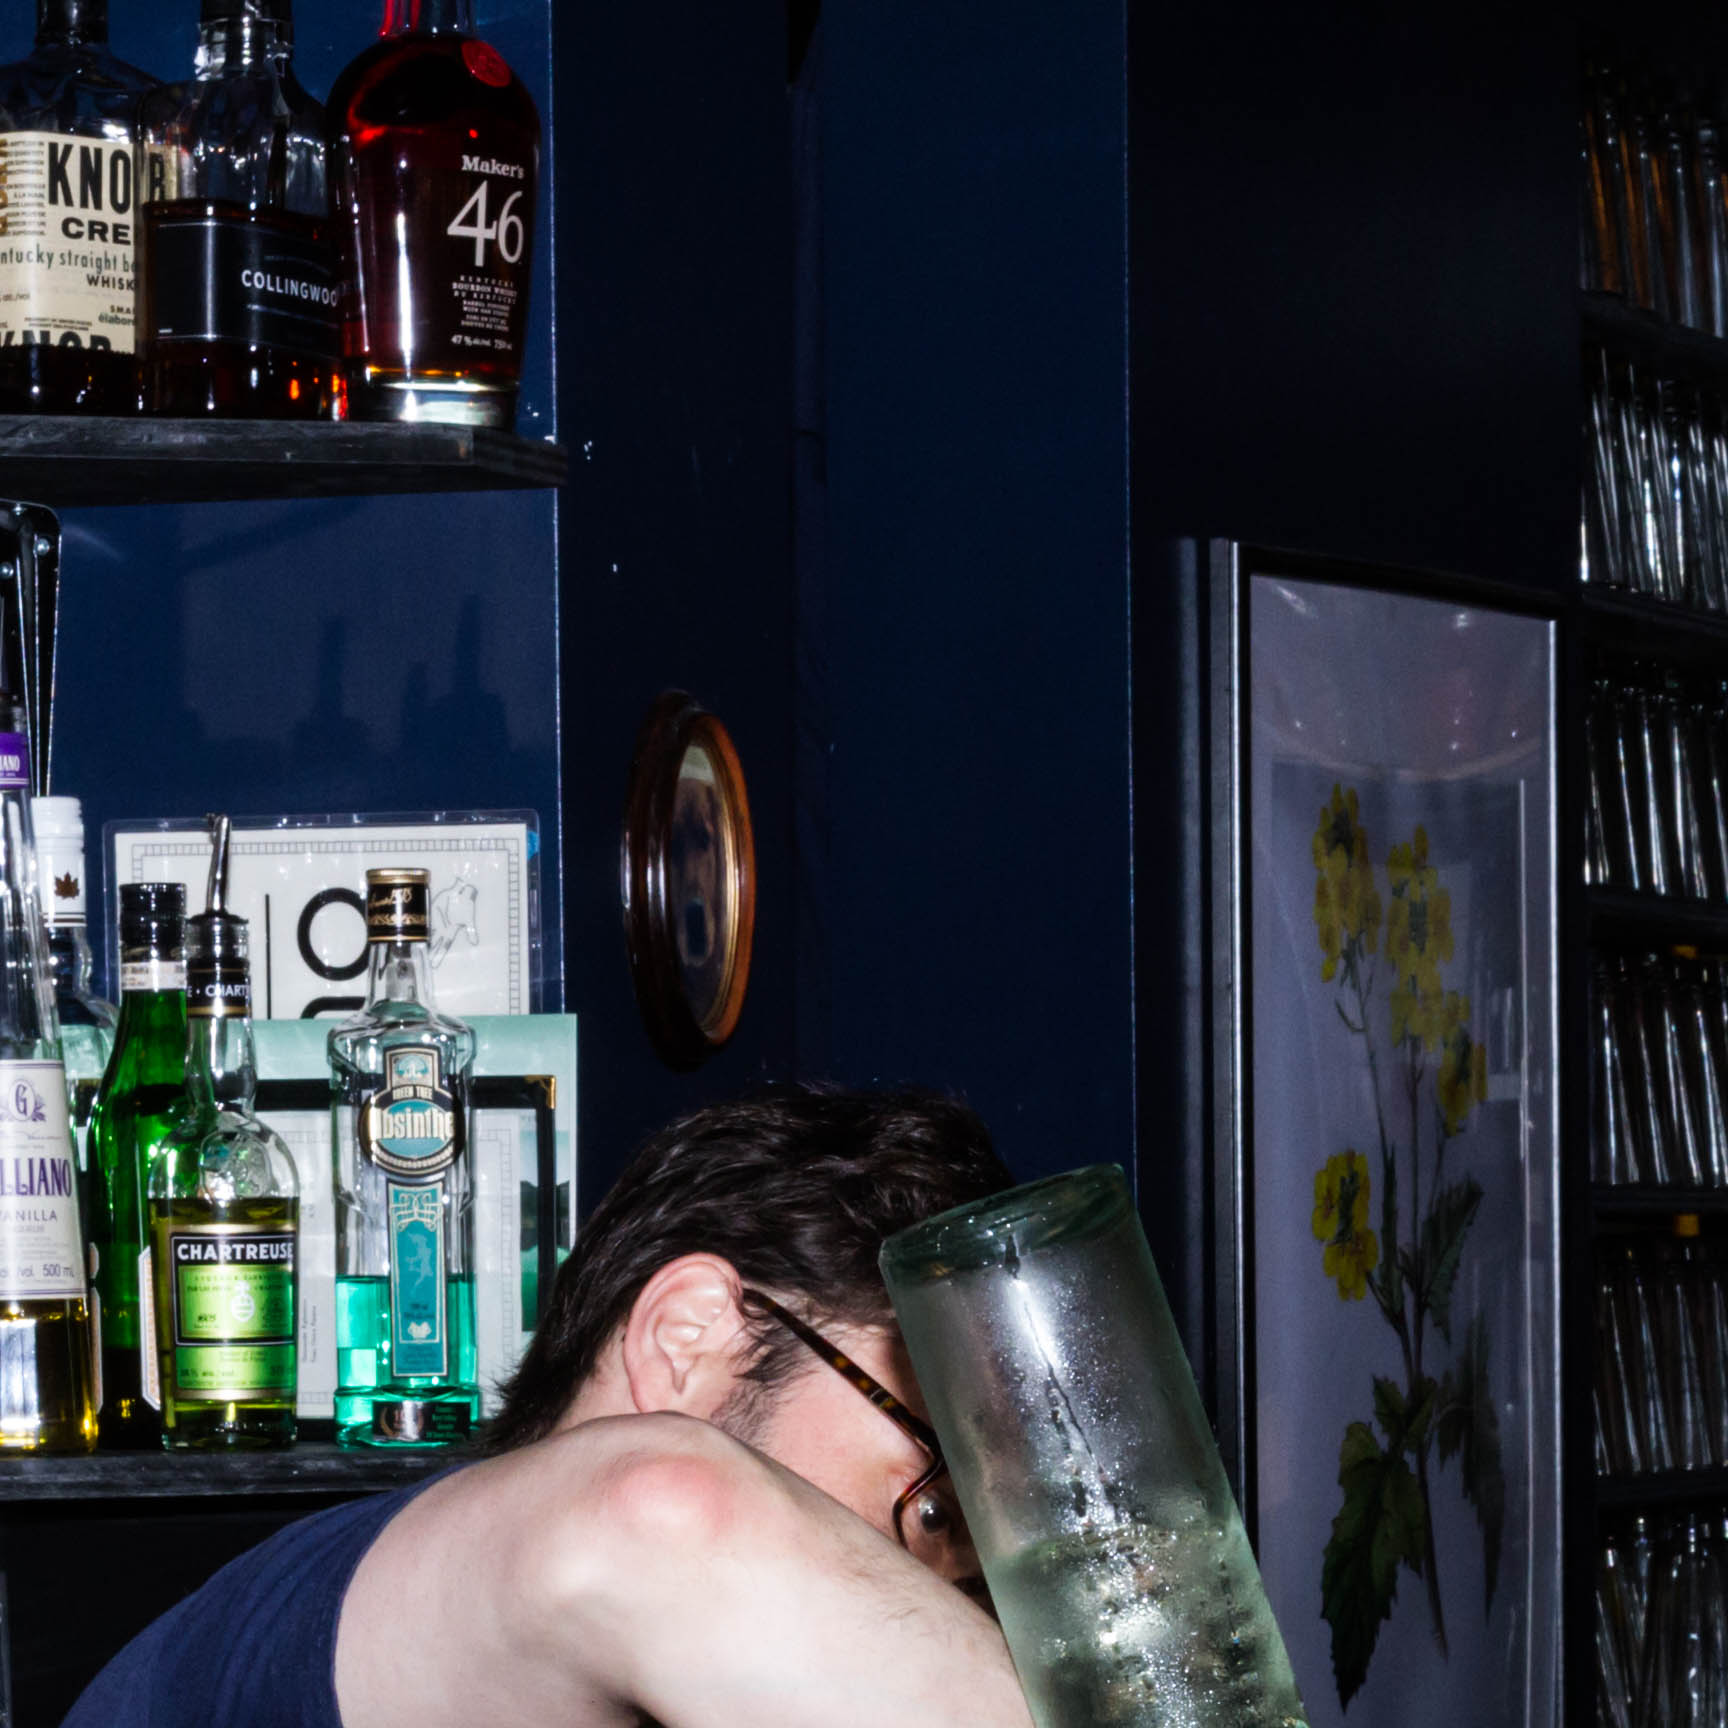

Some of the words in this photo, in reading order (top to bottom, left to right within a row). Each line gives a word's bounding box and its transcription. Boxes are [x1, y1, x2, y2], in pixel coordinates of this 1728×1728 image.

[461, 154, 525, 179] Maker's
[60, 216, 132, 246] CRE
[446, 180, 524, 268] 46
[59, 252, 118, 276] straight
[240, 268, 338, 308] COLLINGWOO
[14, 1083, 30, 1117] G
[177, 1242, 295, 1261] CHARTREUSE
[42, 1262, 62, 1278] 500
